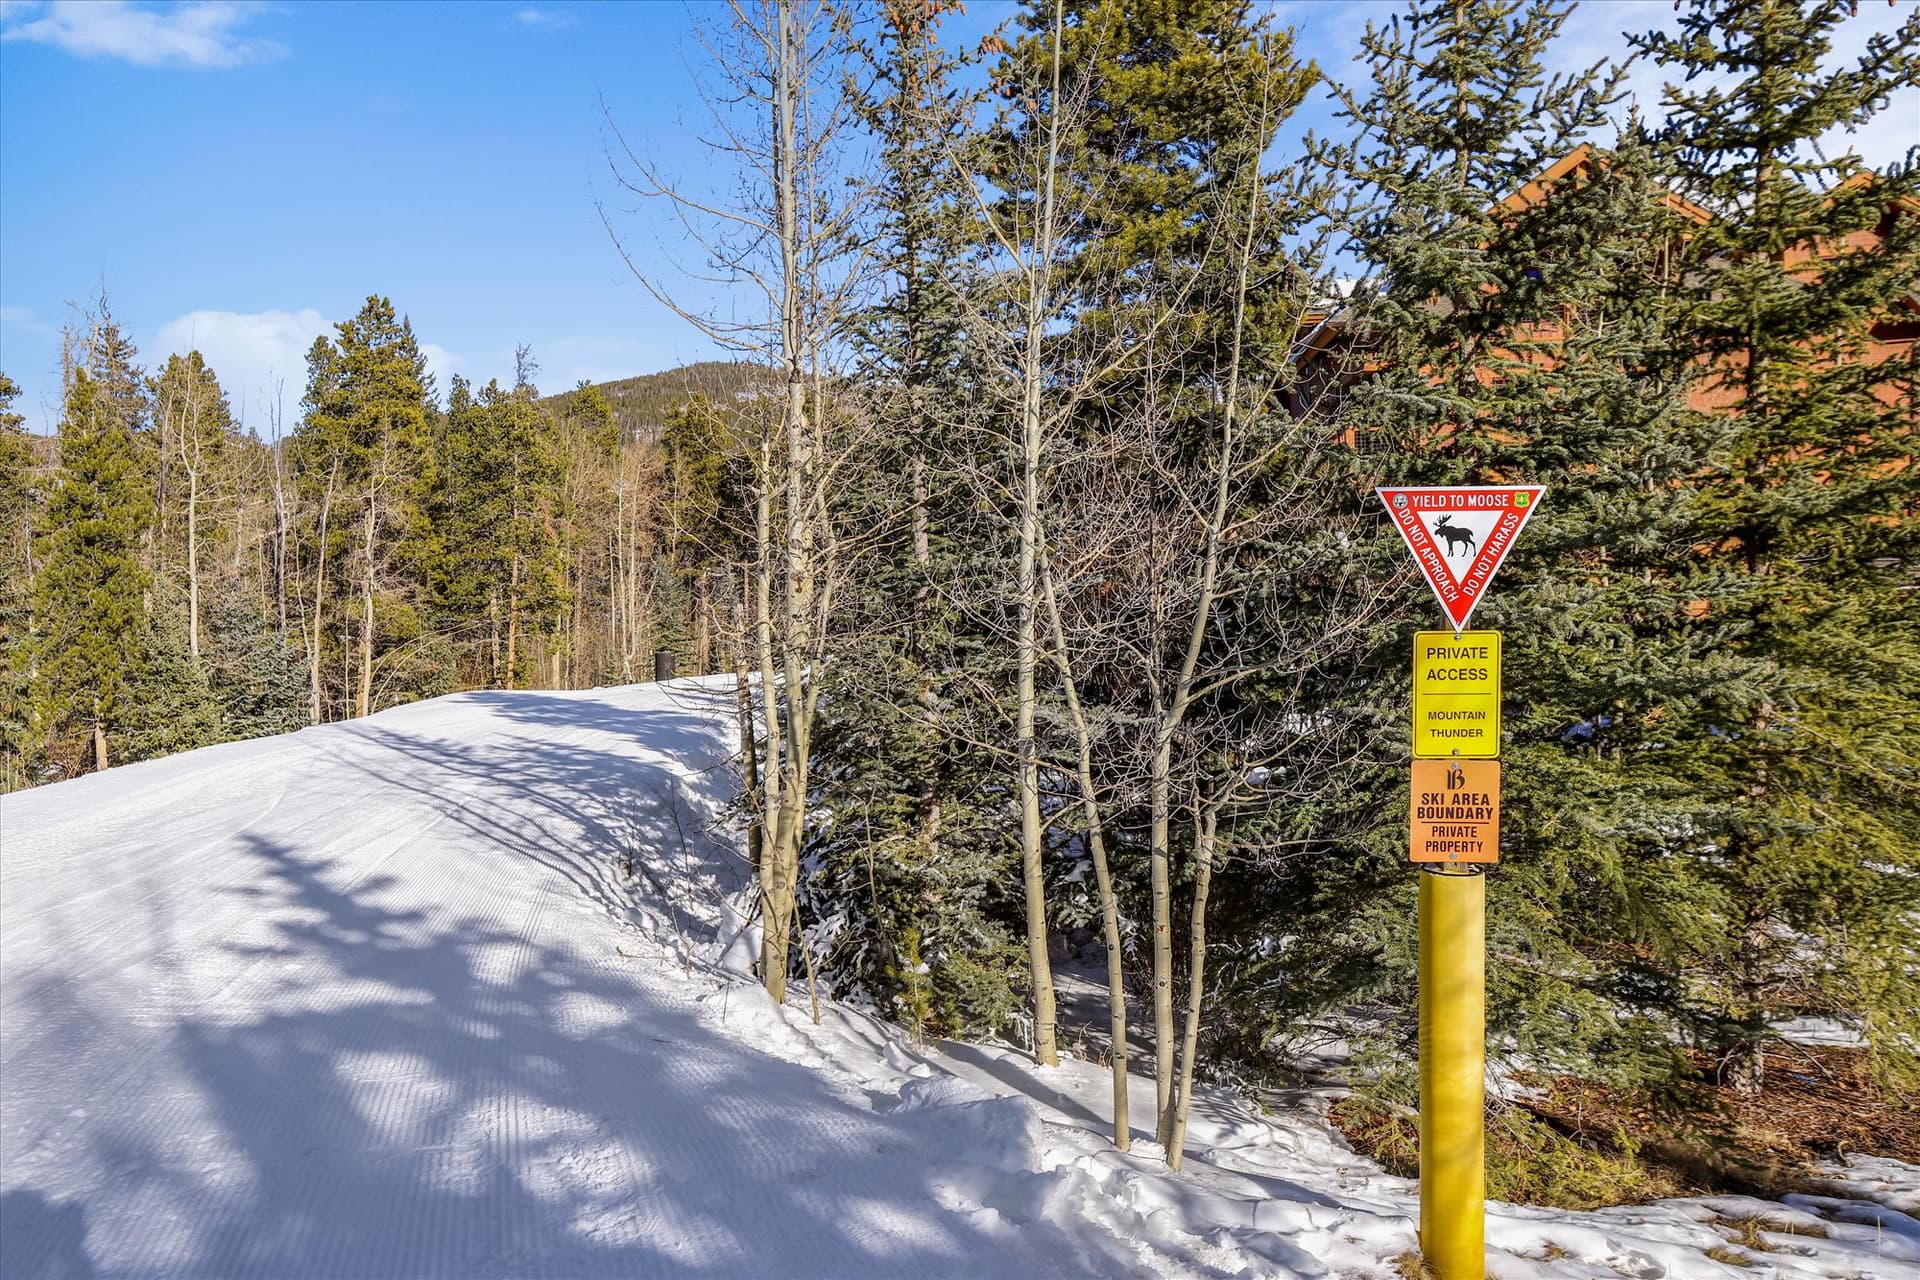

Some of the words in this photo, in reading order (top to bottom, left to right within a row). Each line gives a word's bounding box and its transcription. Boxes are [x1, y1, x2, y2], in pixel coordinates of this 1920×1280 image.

[1412, 495, 1446, 507] YIELD
[1451, 495, 1464, 507] TO
[1468, 494, 1509, 507] MOOSE
[1398, 508, 1414, 526] DO
[1408, 523, 1428, 547] NOT
[1420, 546, 1459, 602] APPROACH
[1463, 577, 1479, 597] DO
[1475, 555, 1493, 580] NOT
[1487, 512, 1519, 561] HARASS
[1426, 647, 1489, 659] PRIVATE
[1426, 668, 1488, 681] ACCESS
[1428, 711, 1486, 720] MOUNTAIN
[1430, 728, 1483, 738] THUNDER
[1421, 793, 1444, 805] SKI
[1452, 793, 1490, 805] AREA
[1417, 807, 1493, 820] BOUNDARY
[1431, 826, 1477, 838] PRIVATE
[1425, 841, 1483, 853] PROPERTY
